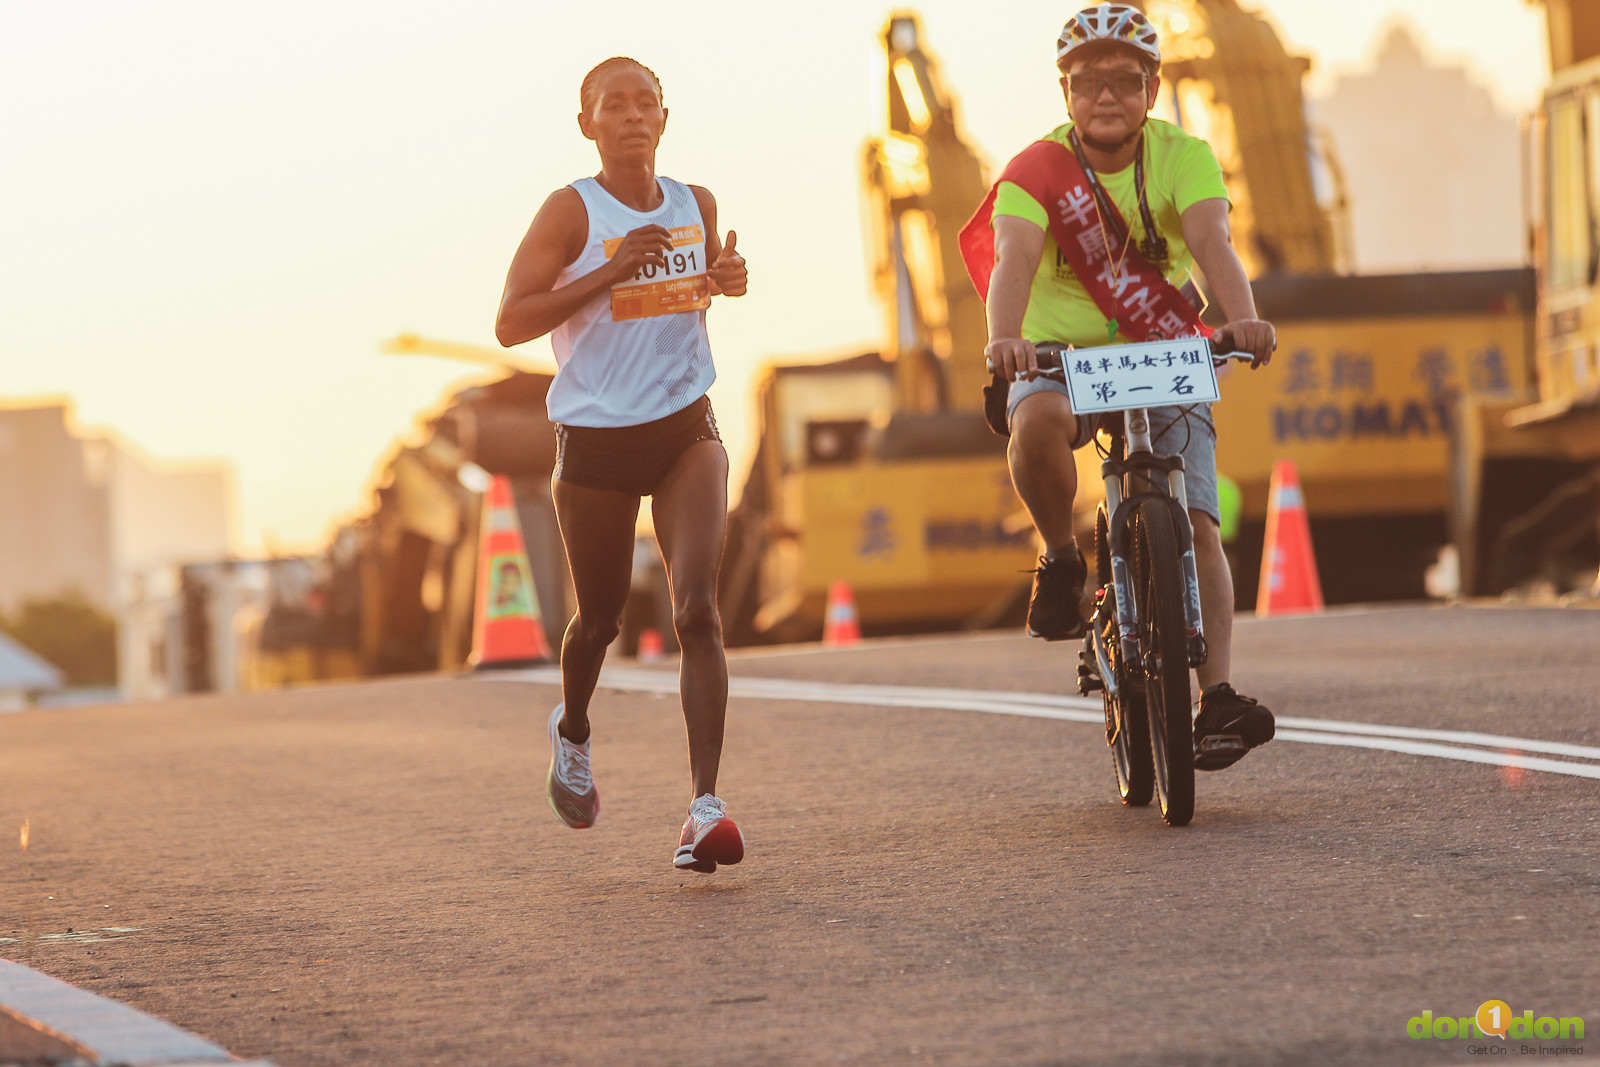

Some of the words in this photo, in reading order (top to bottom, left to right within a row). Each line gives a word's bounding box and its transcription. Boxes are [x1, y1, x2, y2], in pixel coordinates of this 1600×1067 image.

[634, 250, 697, 281] 0191
[1074, 350, 1204, 375] 超半馬女子組
[1091, 375, 1195, 403] 第一名
[1116, 582, 1127, 616] FOX
[1188, 576, 1200, 610] FOX
